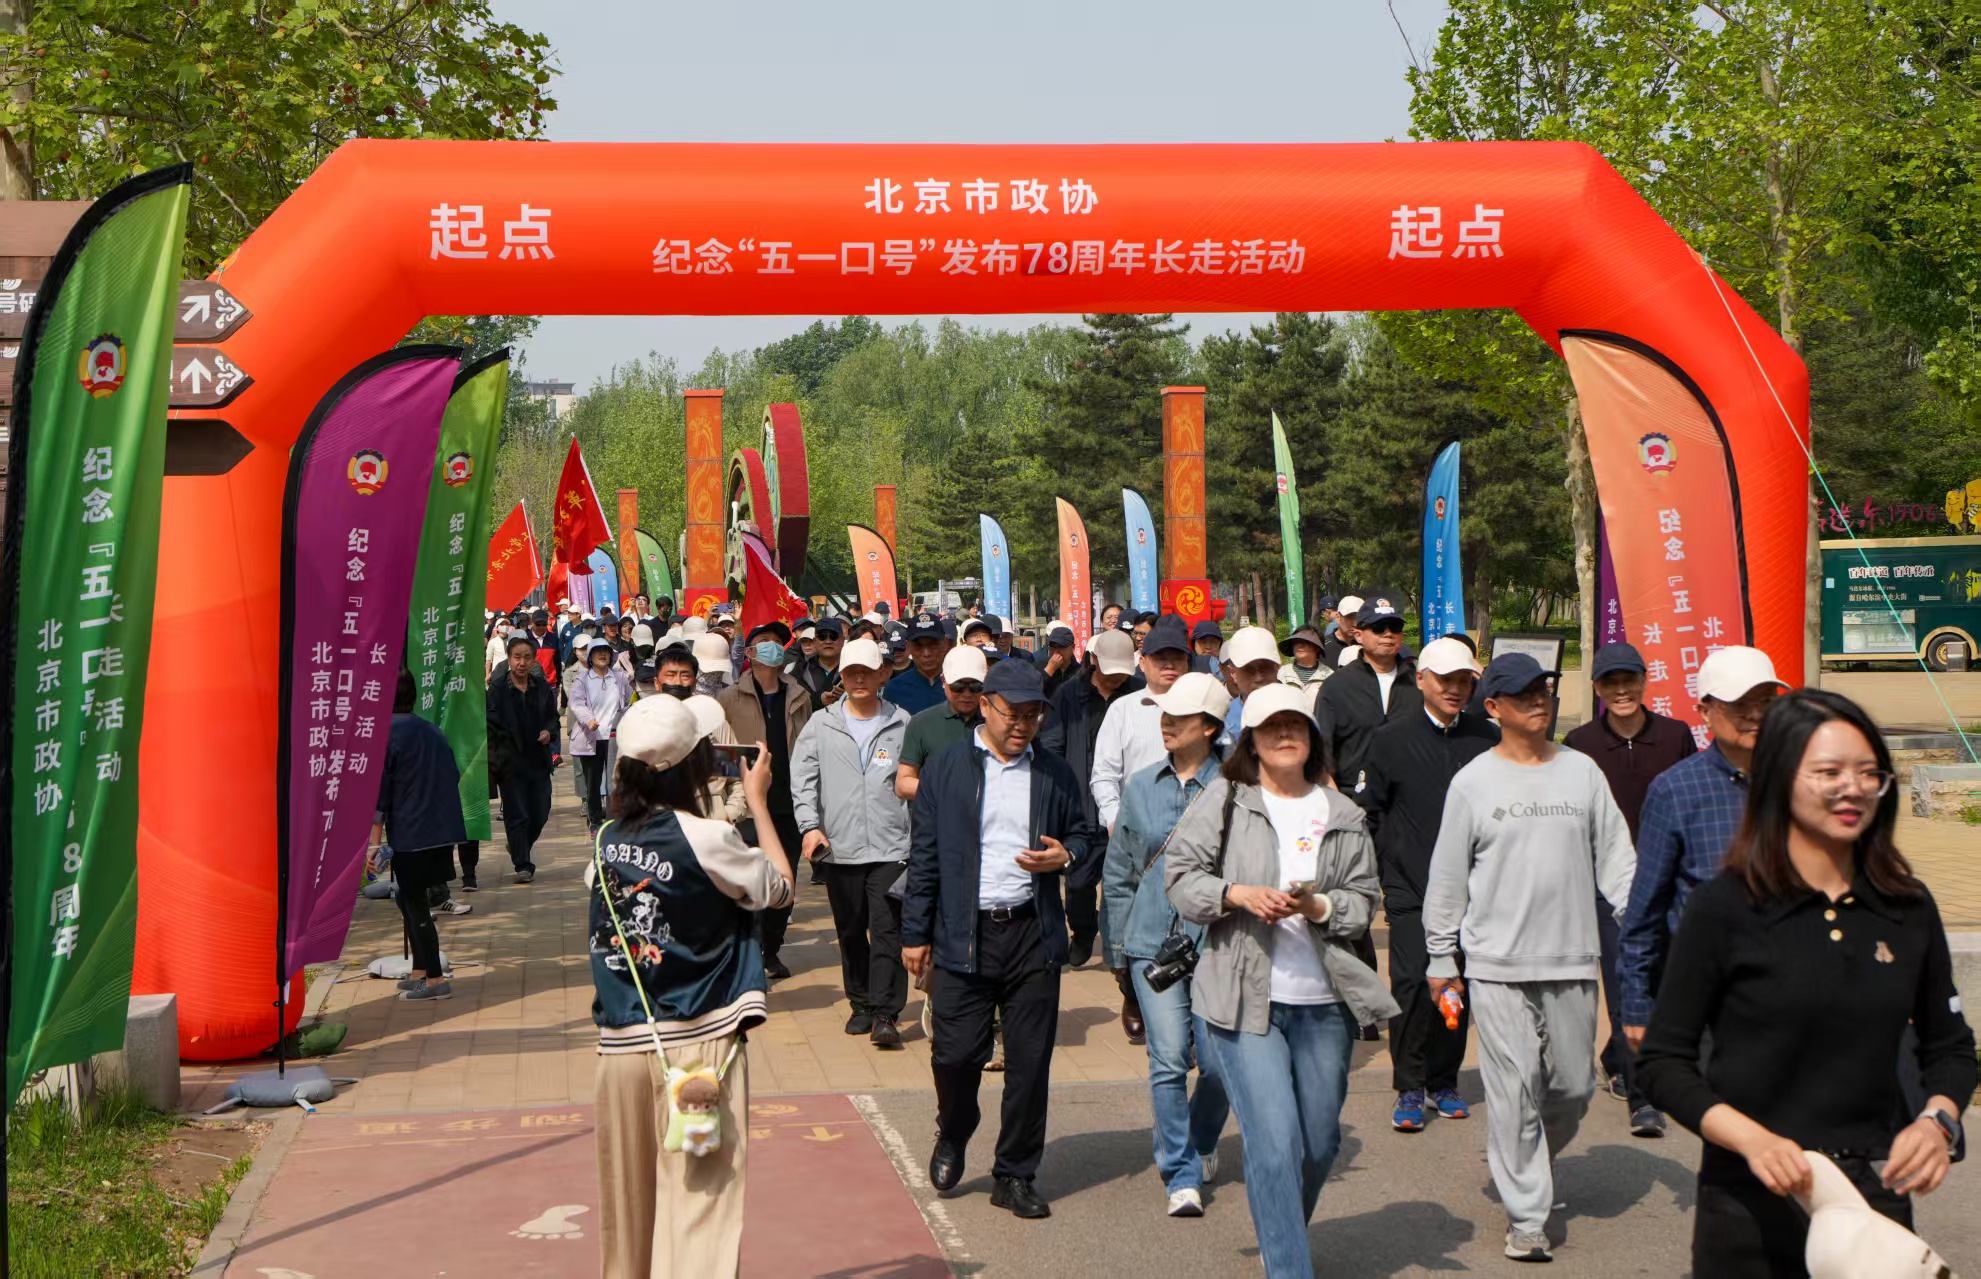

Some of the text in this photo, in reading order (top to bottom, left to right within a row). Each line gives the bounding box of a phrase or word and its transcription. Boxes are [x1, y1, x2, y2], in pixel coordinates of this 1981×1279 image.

[428, 203, 556, 260] 起点
[864, 178, 1099, 215] 北京市政协
[1387, 203, 1504, 260] 起点
[652, 237, 1306, 276] 纪念“五一口号”发布78周年长走活动
[420, 606, 440, 710] 北京市政协
[34, 618, 63, 816] 北京市政协
[308, 641, 333, 778] 北京市政协
[349, 642, 387, 776] 长走活动
